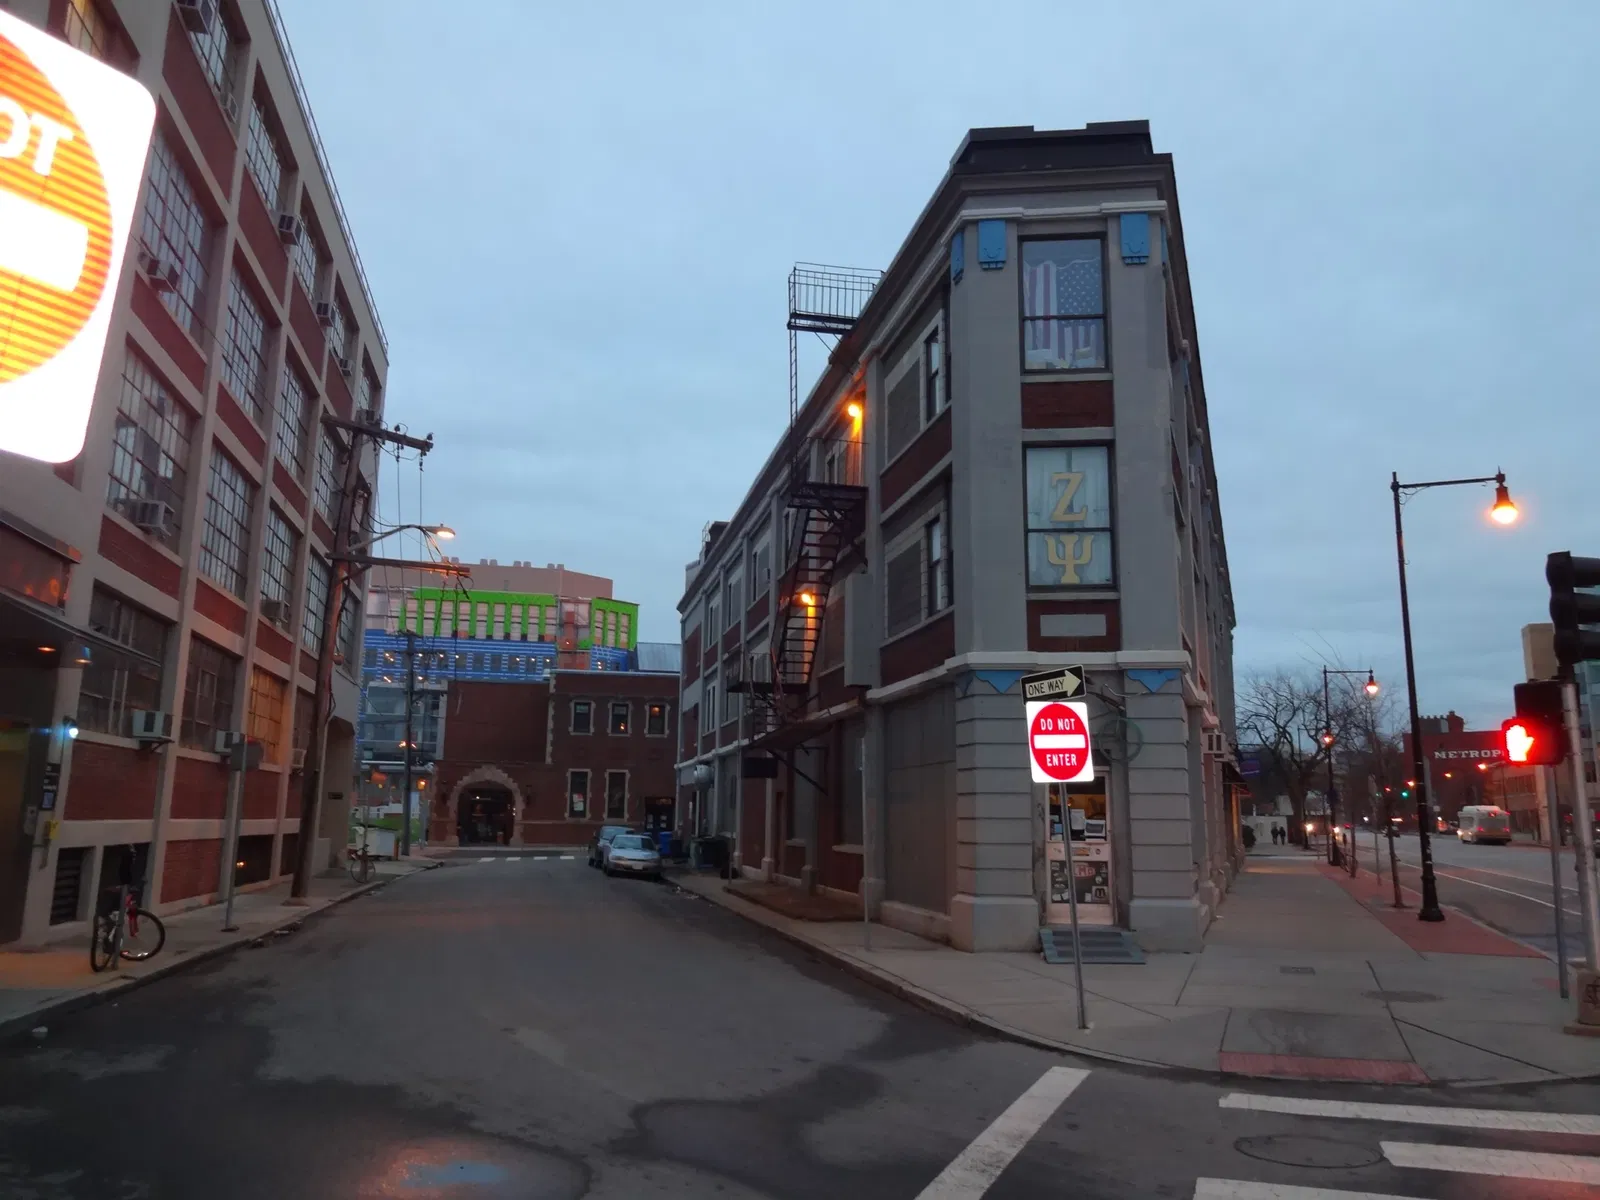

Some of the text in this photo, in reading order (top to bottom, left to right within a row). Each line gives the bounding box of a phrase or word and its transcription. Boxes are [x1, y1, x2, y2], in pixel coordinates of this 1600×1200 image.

[1028, 679, 1065, 696] ONE WAY
[1040, 718, 1075, 731] DO NOT
[1046, 754, 1077, 767] ENTER
[1434, 749, 1505, 759] METROP
